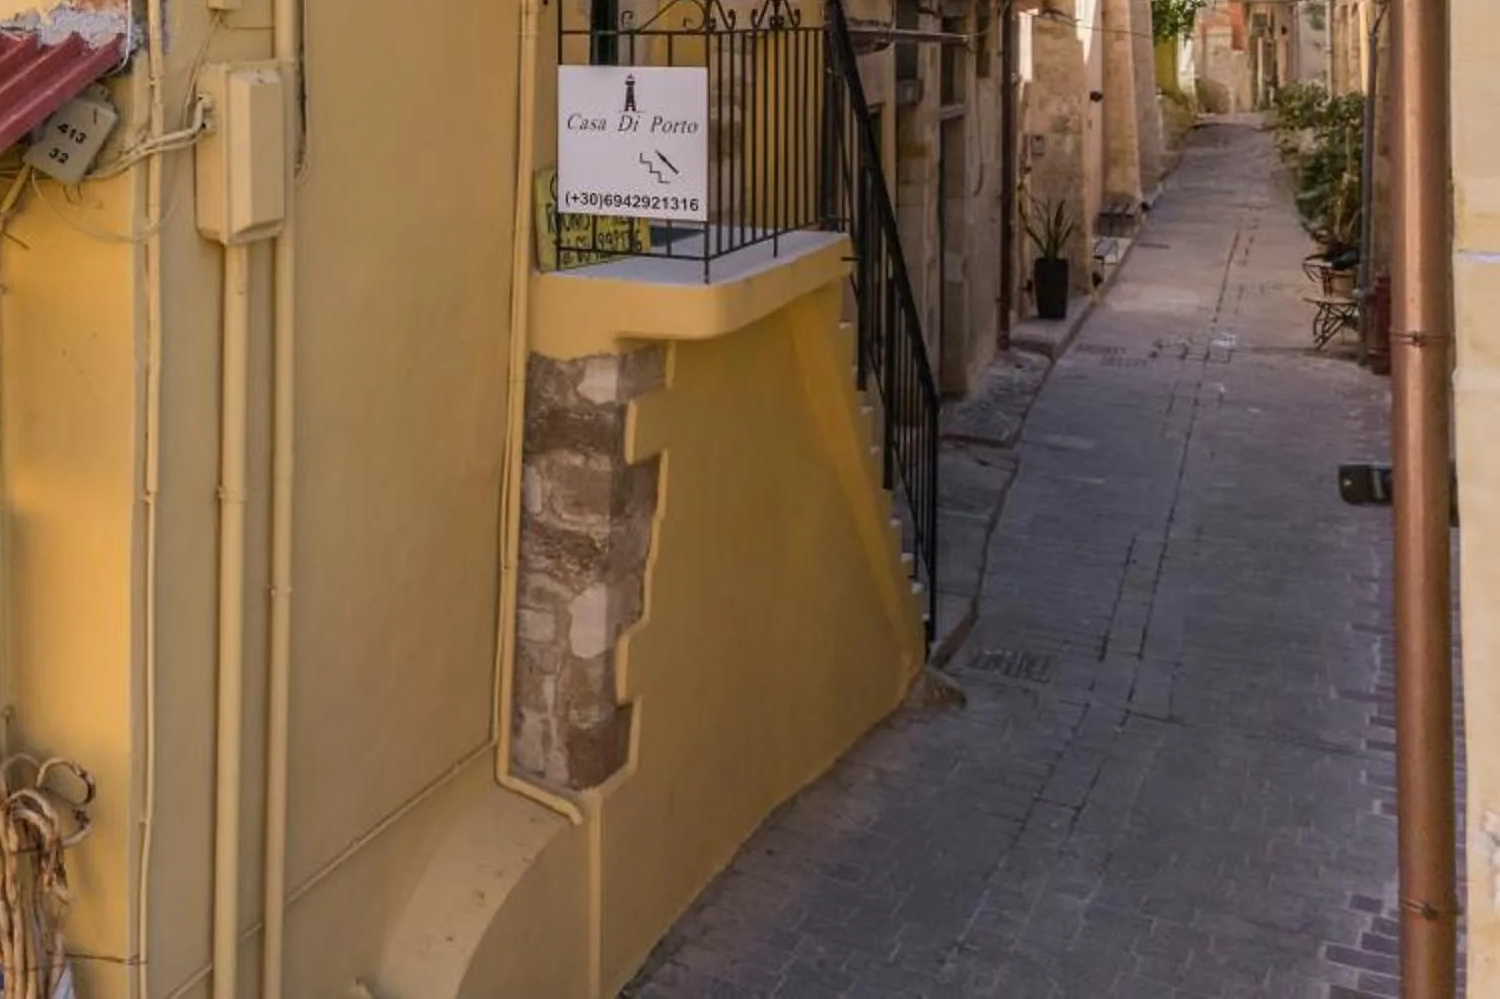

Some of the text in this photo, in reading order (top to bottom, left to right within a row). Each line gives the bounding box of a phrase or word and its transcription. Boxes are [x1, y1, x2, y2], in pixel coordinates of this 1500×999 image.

[567, 113, 699, 134] Casa Di Porto
